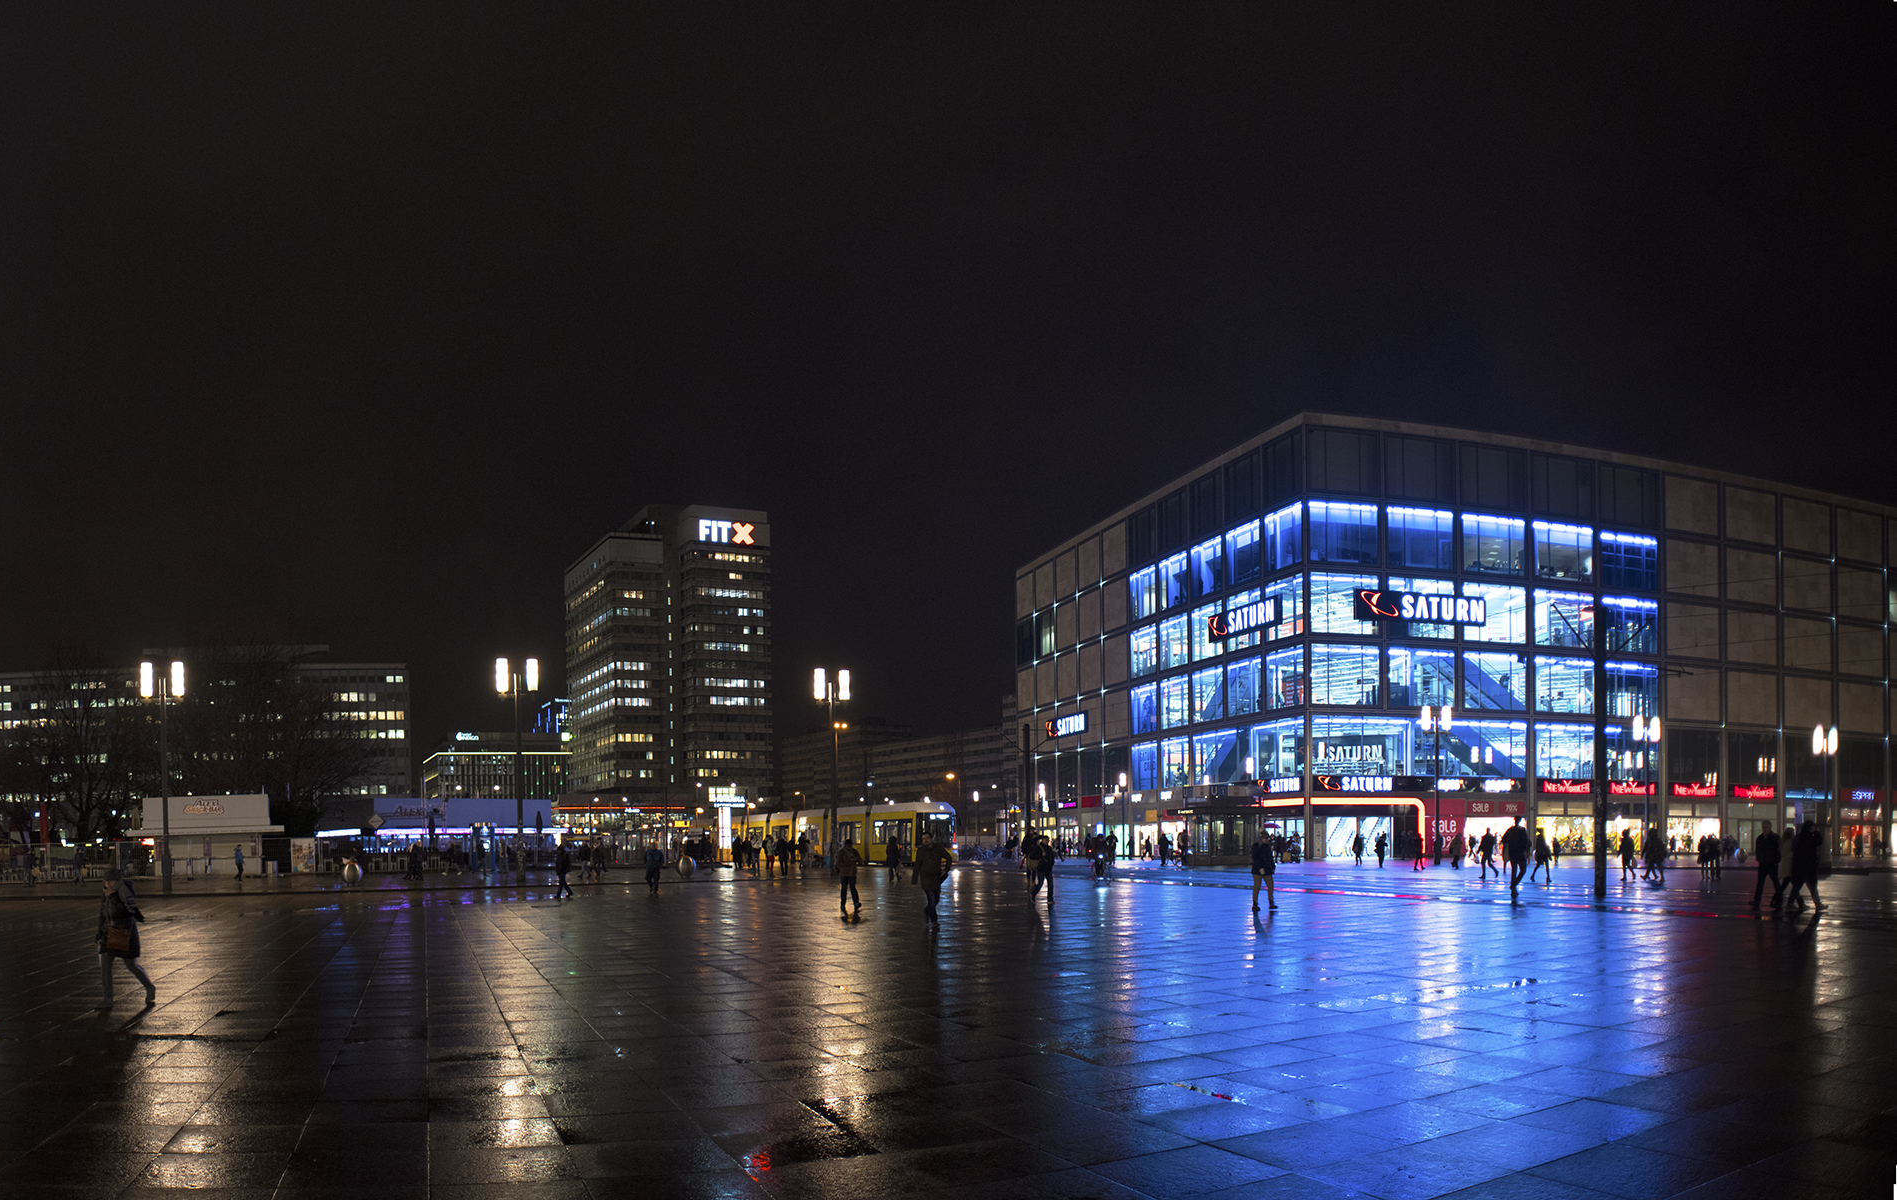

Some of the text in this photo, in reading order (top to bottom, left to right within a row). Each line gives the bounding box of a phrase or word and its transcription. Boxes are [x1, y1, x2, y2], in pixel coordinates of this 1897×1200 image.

[1227, 598, 1275, 634] SATURN
[1402, 595, 1485, 623] SATURN
[1057, 713, 1085, 737] SATURN
[1269, 777, 1300, 793] SATURN
[1341, 776, 1393, 791] SATURN
[1852, 790, 1875, 800] ESPRIT
